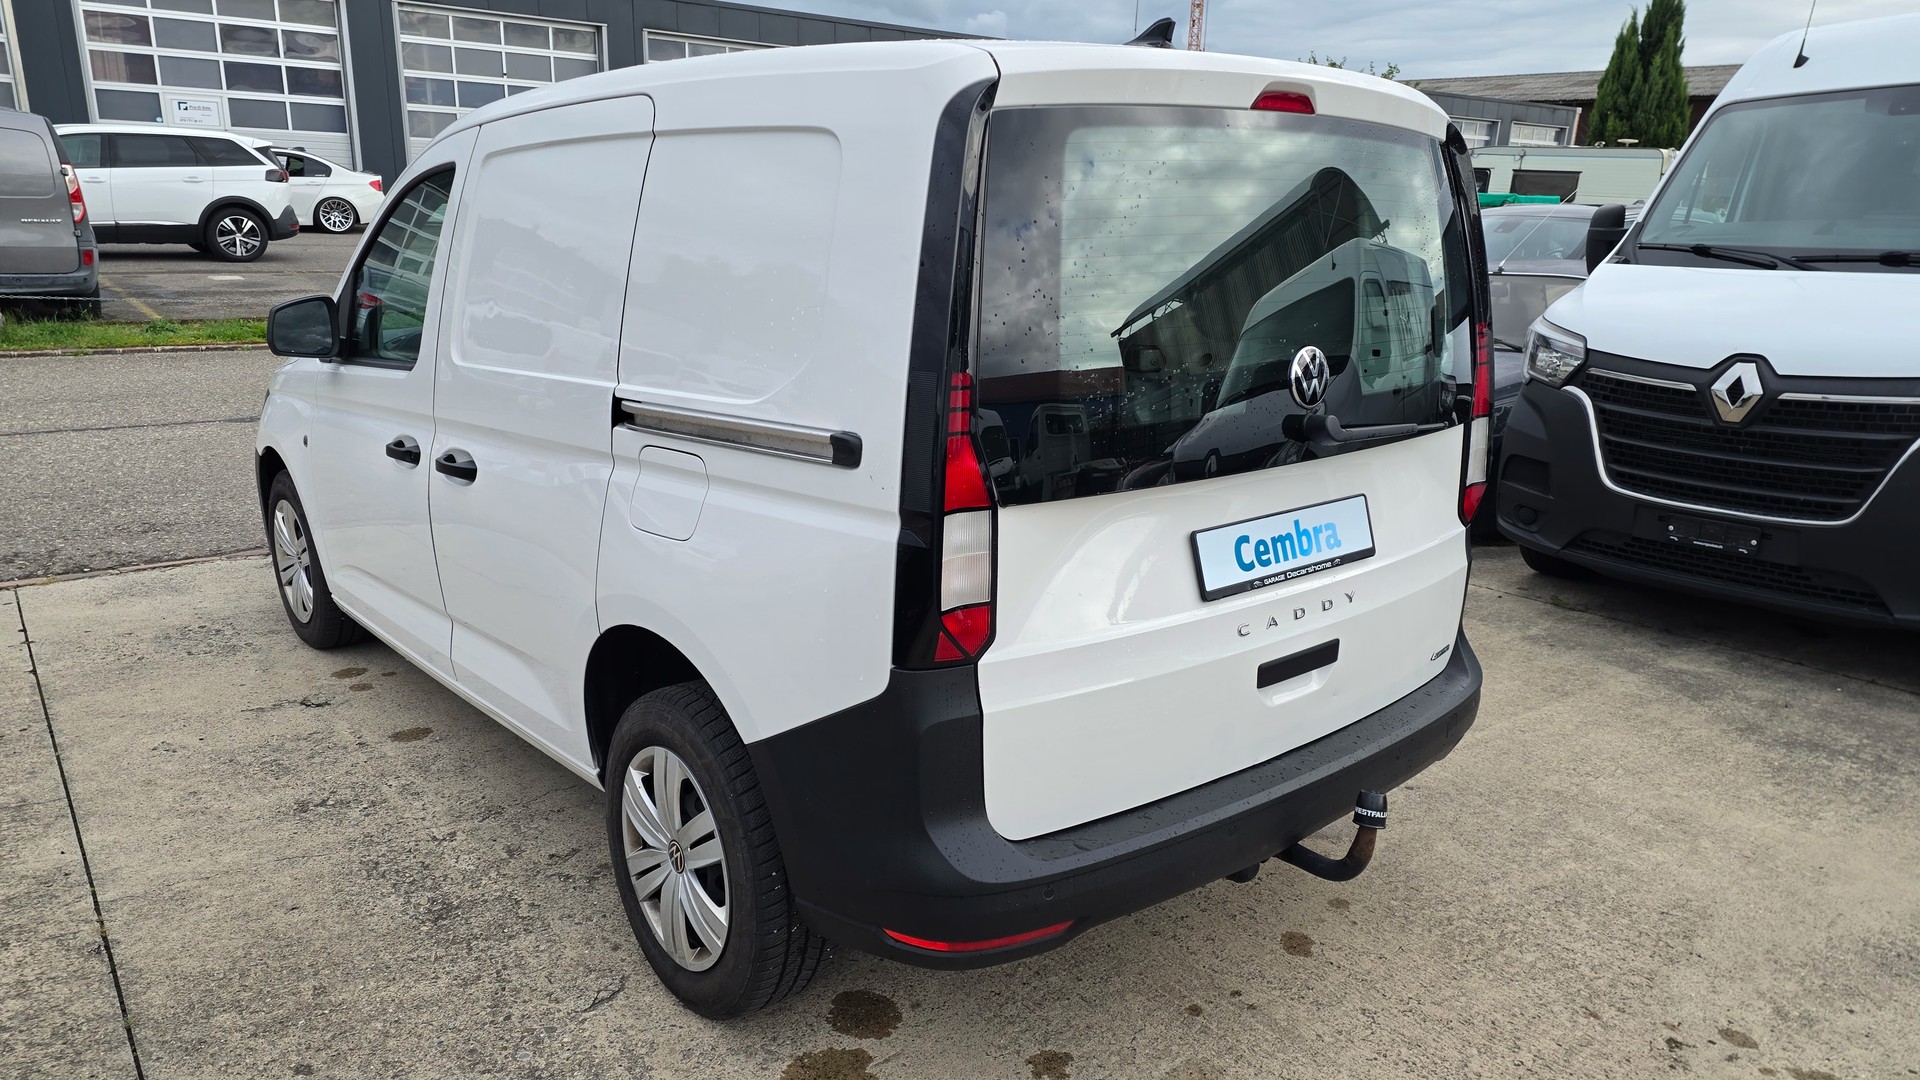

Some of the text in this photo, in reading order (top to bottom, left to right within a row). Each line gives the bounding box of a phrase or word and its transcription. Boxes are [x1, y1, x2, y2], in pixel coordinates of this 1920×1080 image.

[1234, 519, 1342, 572] Cembra
[1263, 561, 1332, 585] GARAGE Decarshome
[1237, 590, 1356, 637] CADDY
